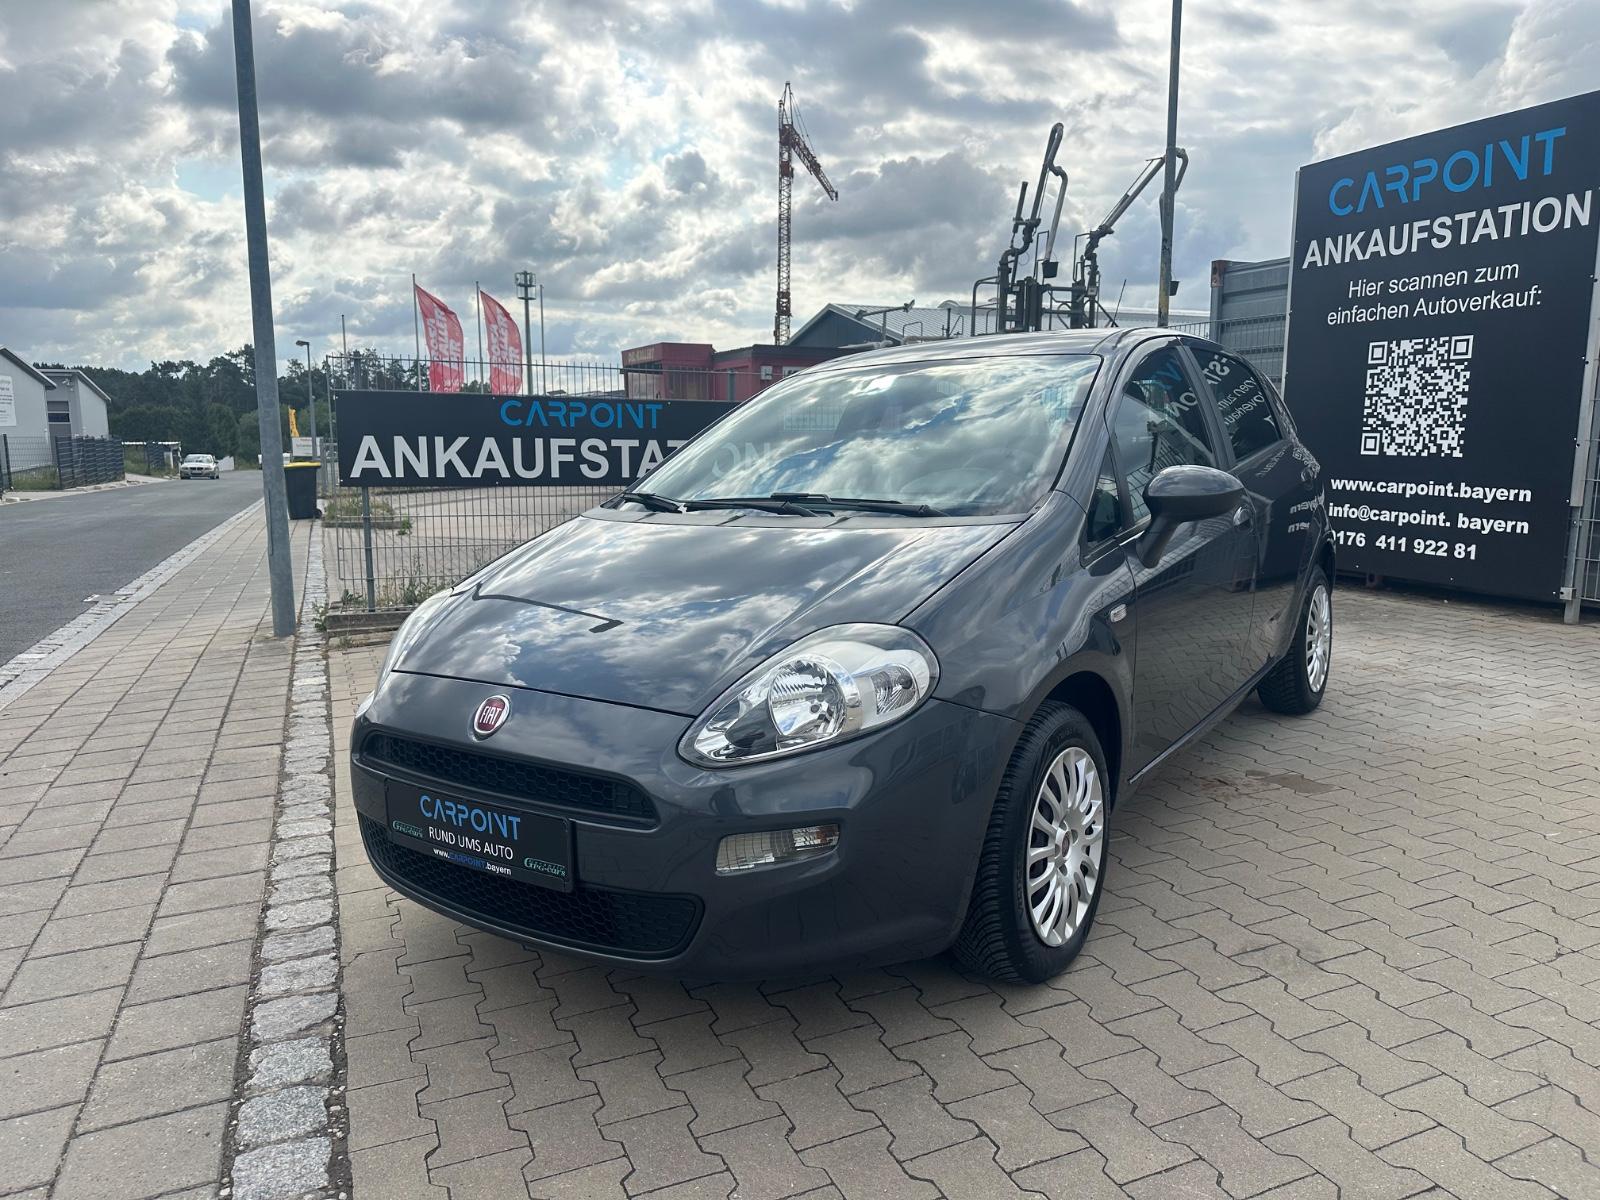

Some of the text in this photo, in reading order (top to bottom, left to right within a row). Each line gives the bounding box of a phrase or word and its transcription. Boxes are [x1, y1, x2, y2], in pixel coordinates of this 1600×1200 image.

[1329, 127, 1566, 216] CARPOINT
[1302, 190, 1593, 269] ANKAUFSTATION
[1349, 263, 1520, 299] Hier scannen zum
[1327, 285, 1543, 326] einfachen Autoverkauf:
[500, 400, 663, 429] CARPOINT
[1331, 478, 1532, 504] www.carpoint.bayern
[1328, 503, 1451, 527] info@carpoint.
[1457, 513, 1529, 535] bayern
[1331, 530, 1477, 560] 176 411 922 81
[480, 704, 502, 725] FIAT
[419, 794, 521, 841] CARPOINT
[429, 826, 514, 860] RUND UMS AUTO
